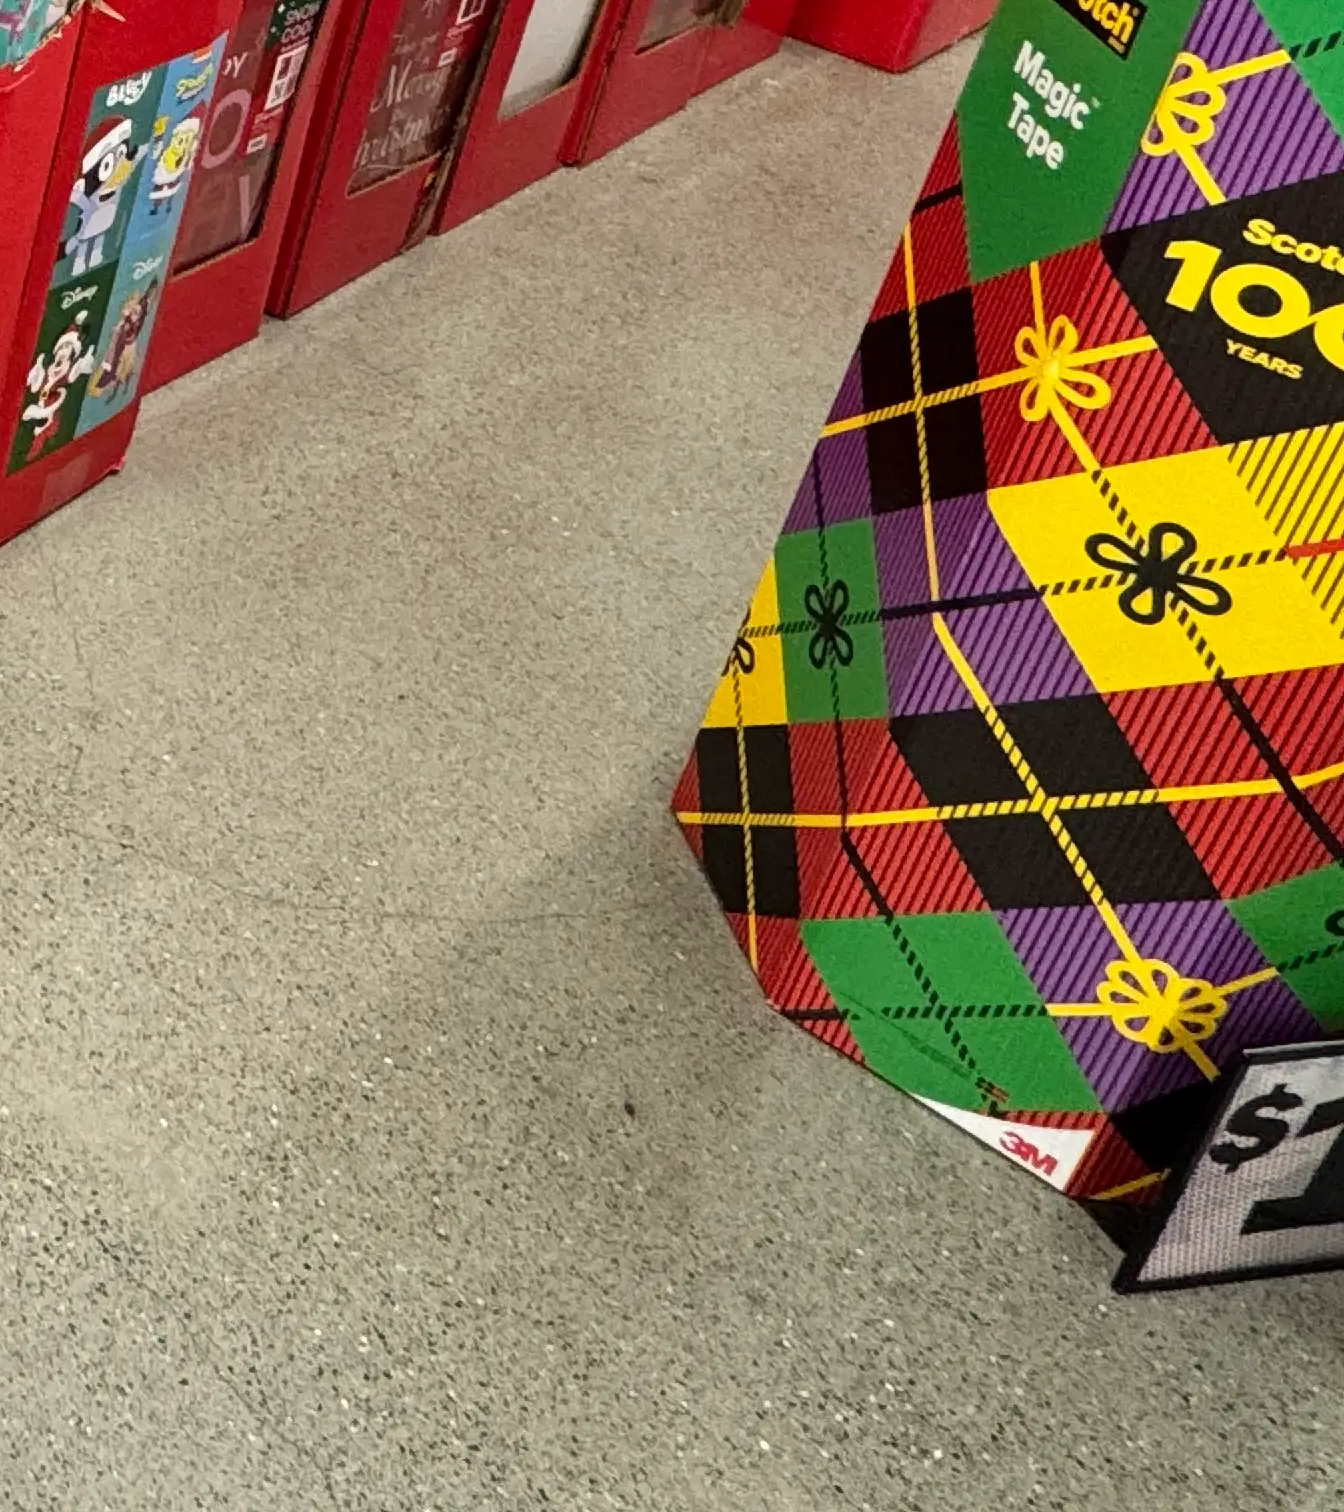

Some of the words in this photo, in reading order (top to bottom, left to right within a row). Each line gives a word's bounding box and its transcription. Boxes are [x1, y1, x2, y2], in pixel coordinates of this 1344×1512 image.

[1013, 41, 1092, 131] Magic
[1007, 93, 1065, 171] Tape
[1242, 218, 1344, 275] Scot
[1225, 338, 1304, 382] YEARS
[998, 1130, 1058, 1179] 3M
